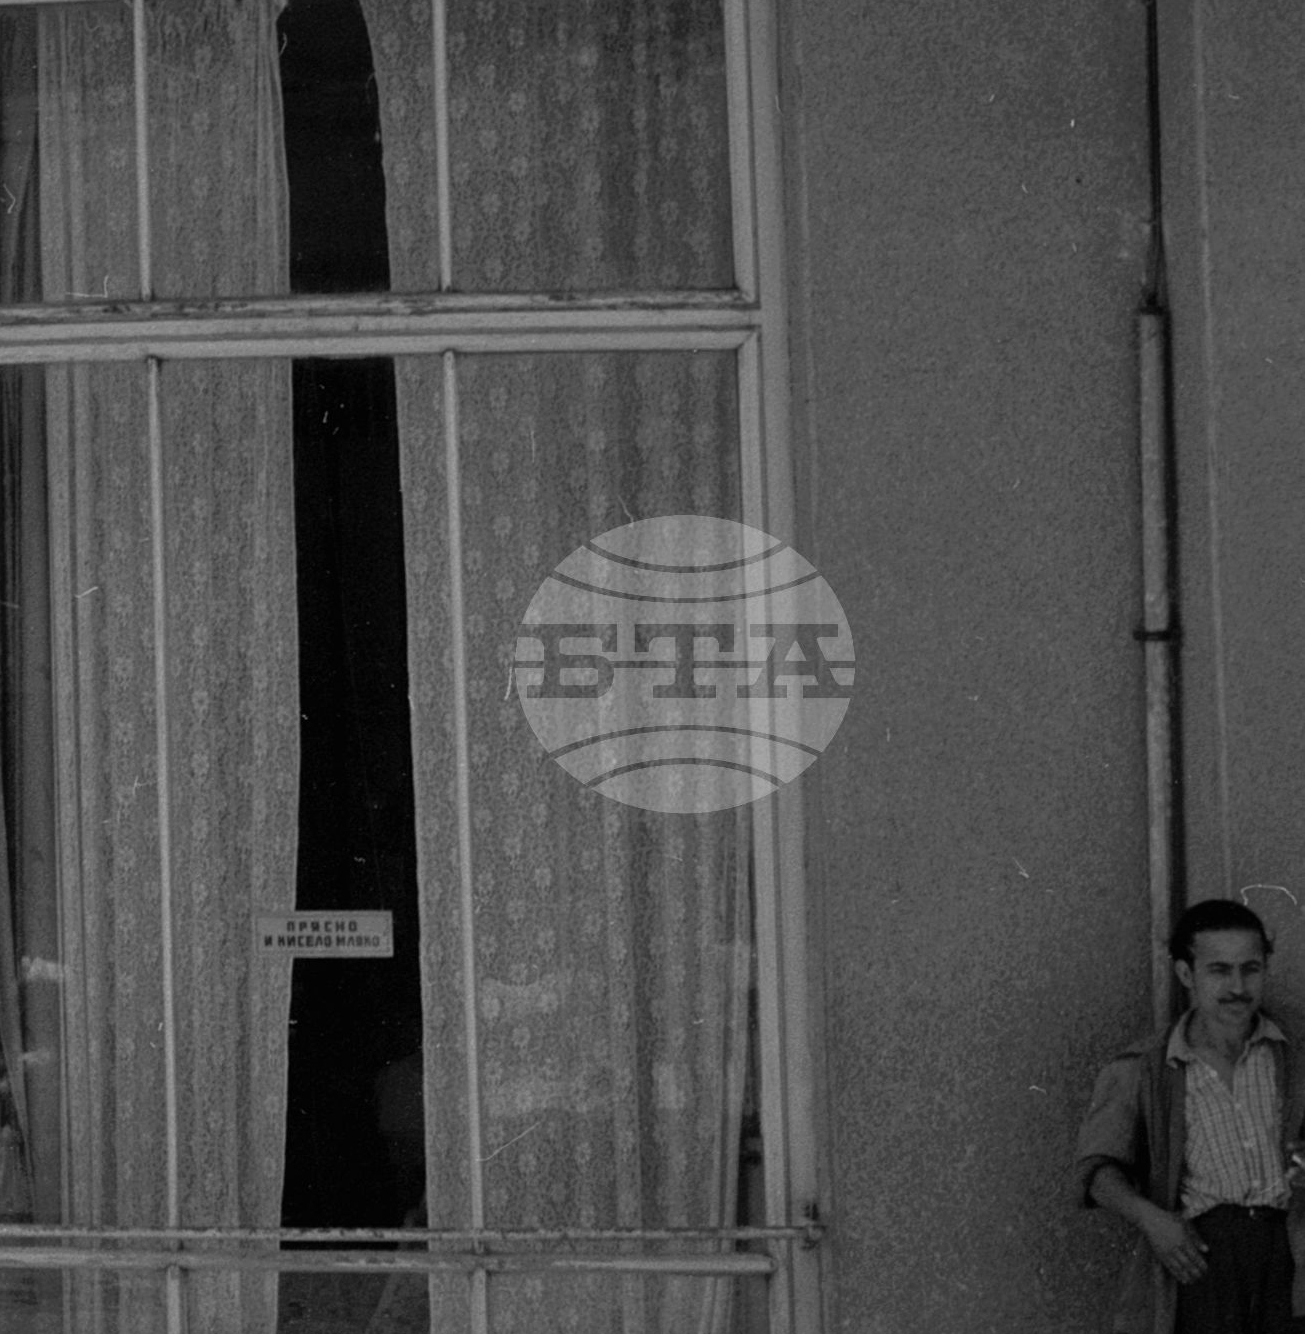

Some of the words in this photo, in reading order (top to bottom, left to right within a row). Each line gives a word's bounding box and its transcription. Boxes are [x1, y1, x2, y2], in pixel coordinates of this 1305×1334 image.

[286, 920, 359, 933] ПРЯСНО
[263, 935, 274, 948] И
[277, 935, 333, 948] КИСЕЛО
[335, 935, 381, 948] МЛЯКО
